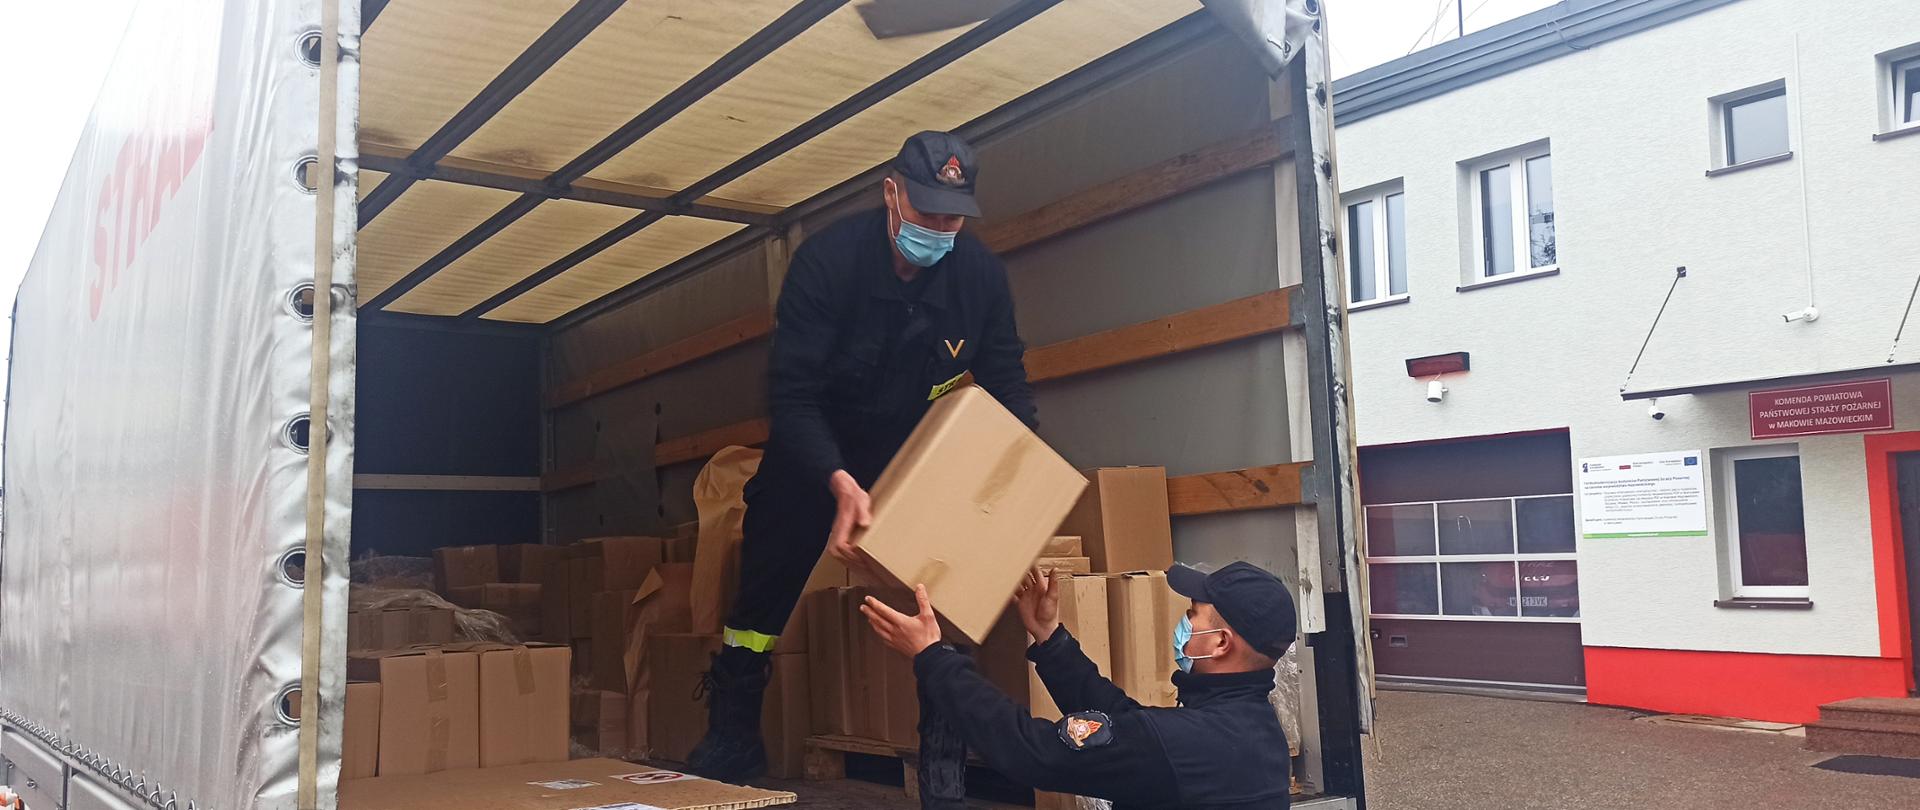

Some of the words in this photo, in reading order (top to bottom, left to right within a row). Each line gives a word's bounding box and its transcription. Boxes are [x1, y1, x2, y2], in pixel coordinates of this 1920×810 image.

[1774, 394, 1812, 406] KOMENDA
[1813, 391, 1863, 403] POWIATOWA
[1759, 406, 1810, 418] PAŃSTWOWEJ
[1811, 403, 1839, 415] STRAŻY
[1841, 401, 1881, 412] POŻARNEJ
[1768, 422, 1776, 430] w
[1776, 417, 1814, 429] MAKOWIE
[1815, 414, 1873, 426] MAZOWIECKIM
